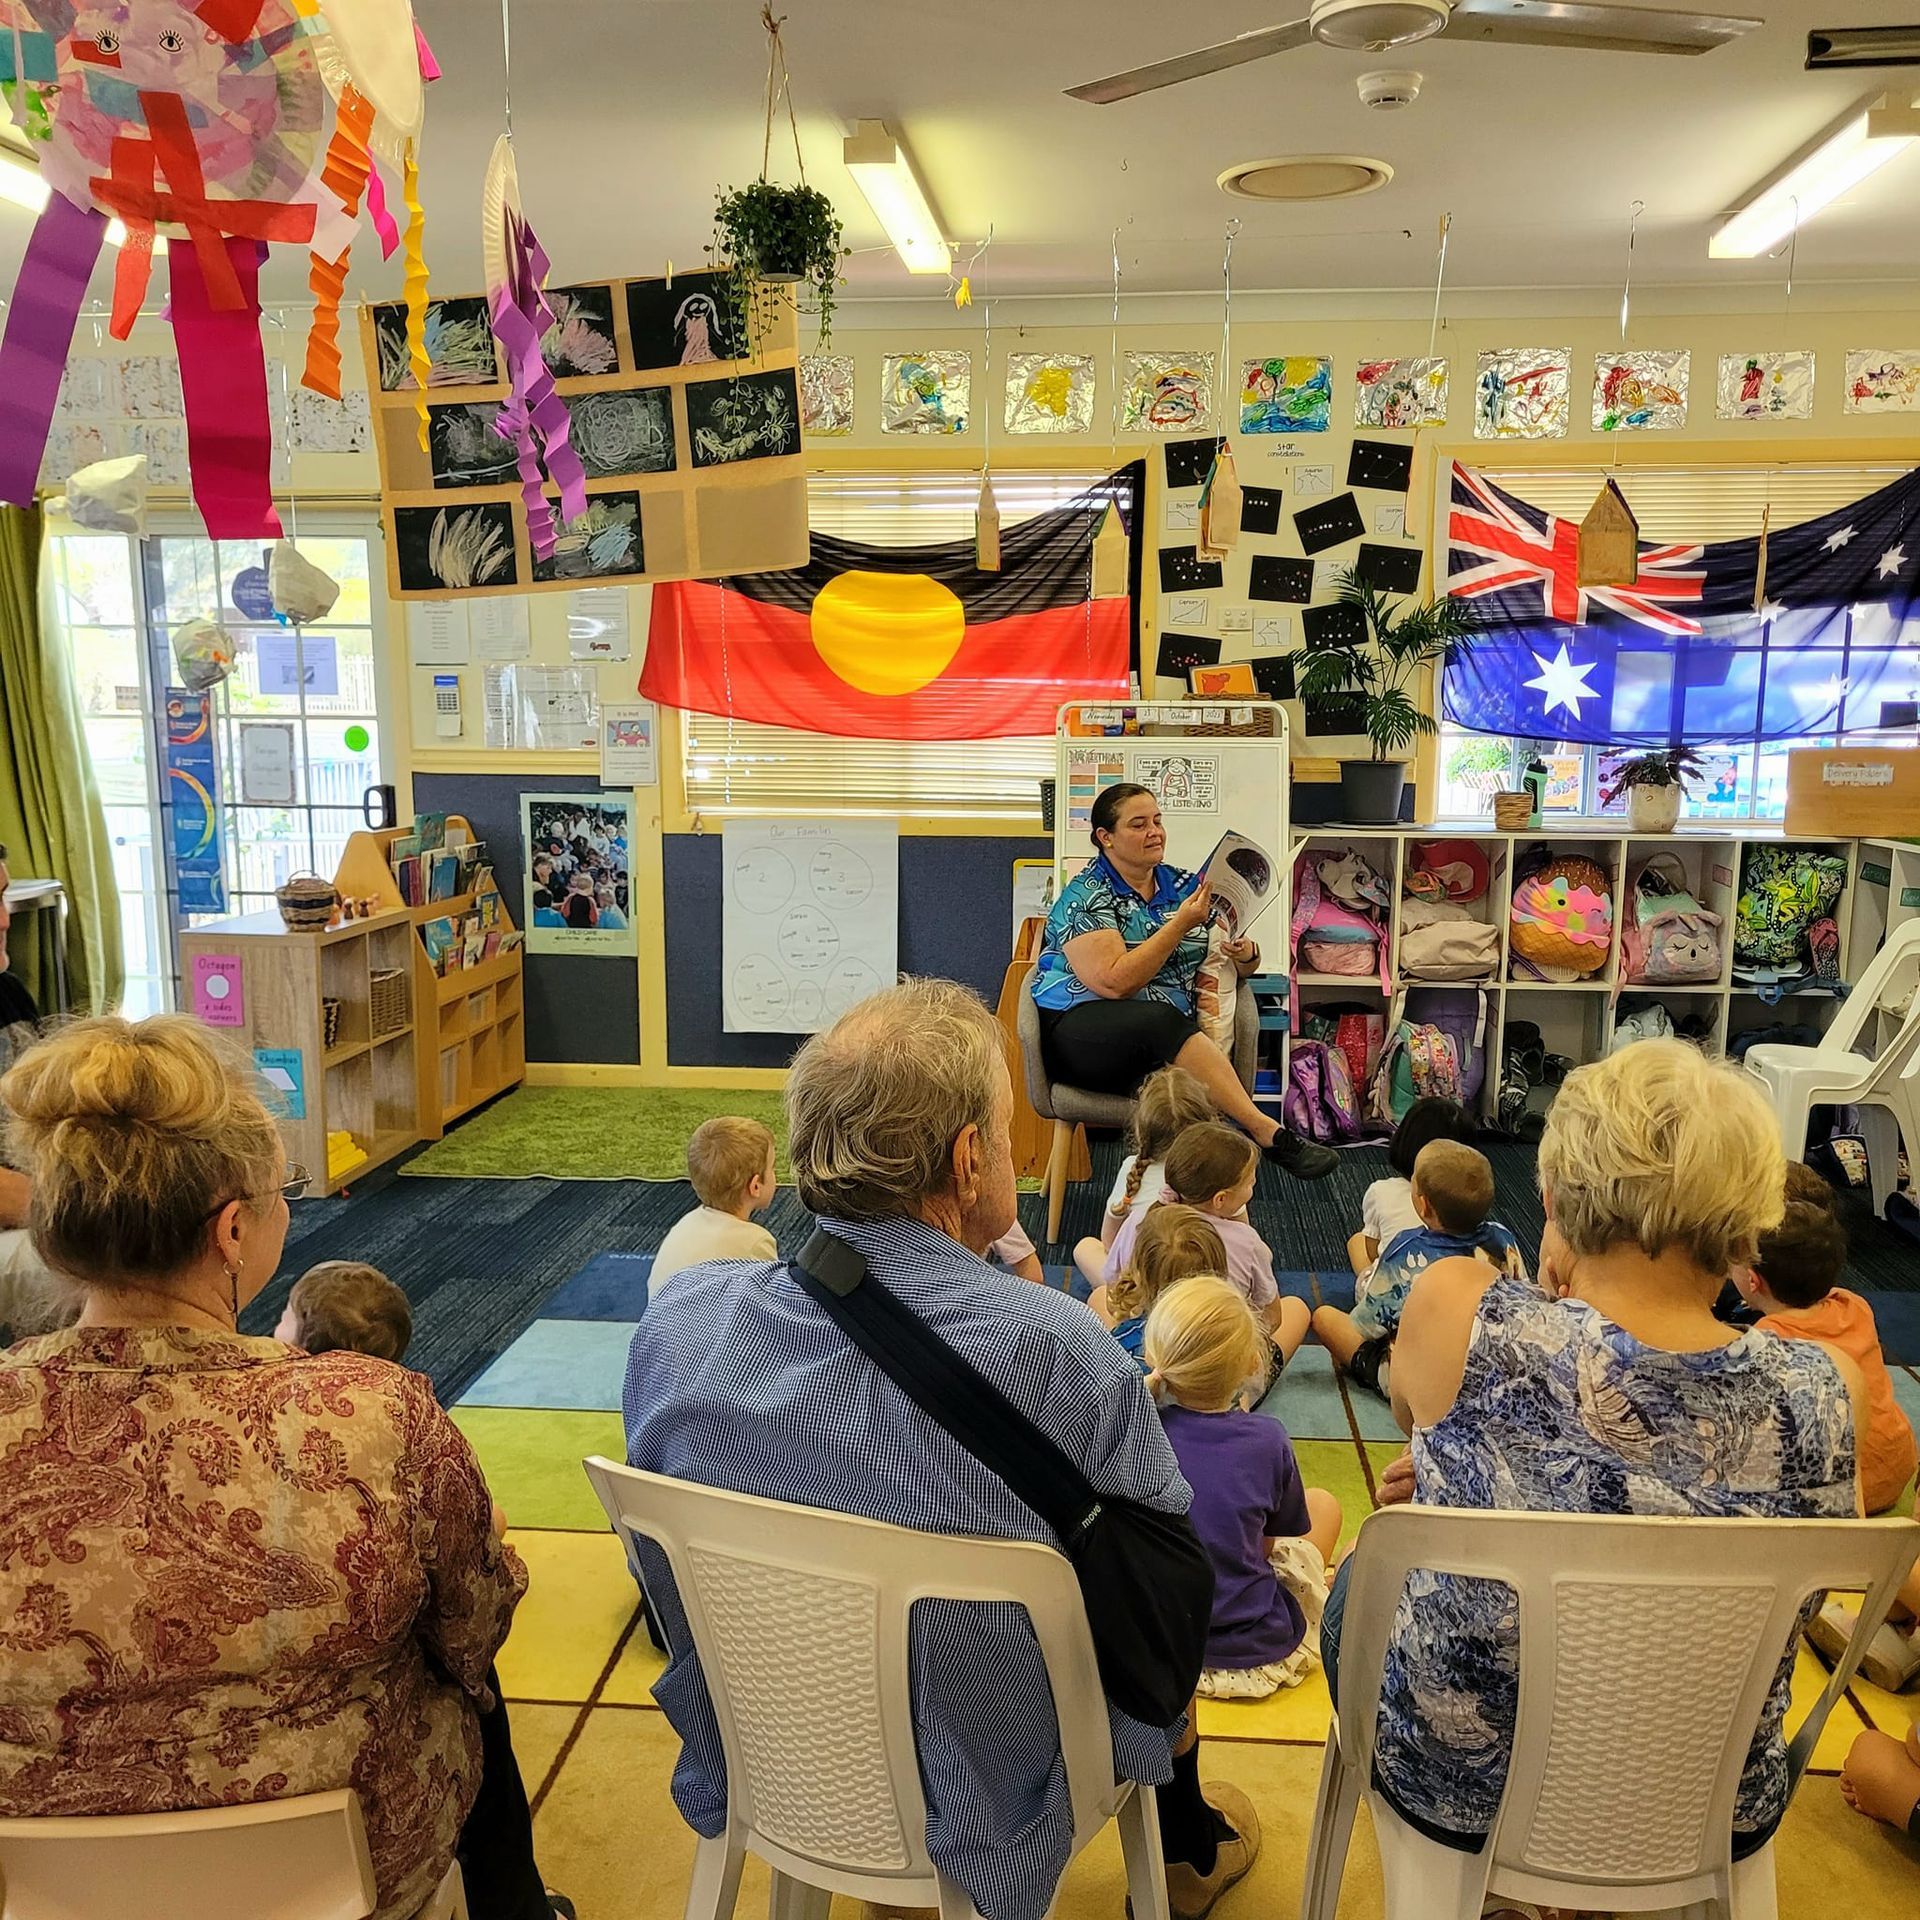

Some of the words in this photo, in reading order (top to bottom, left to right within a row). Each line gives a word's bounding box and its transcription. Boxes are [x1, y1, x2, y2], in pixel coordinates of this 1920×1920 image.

[1170, 712, 1192, 720] October
[1172, 799, 1212, 808] LISTENING
[769, 825, 785, 837] Our
[198, 958, 236, 973] Octagon
[258, 1052, 298, 1065] Rhombus
